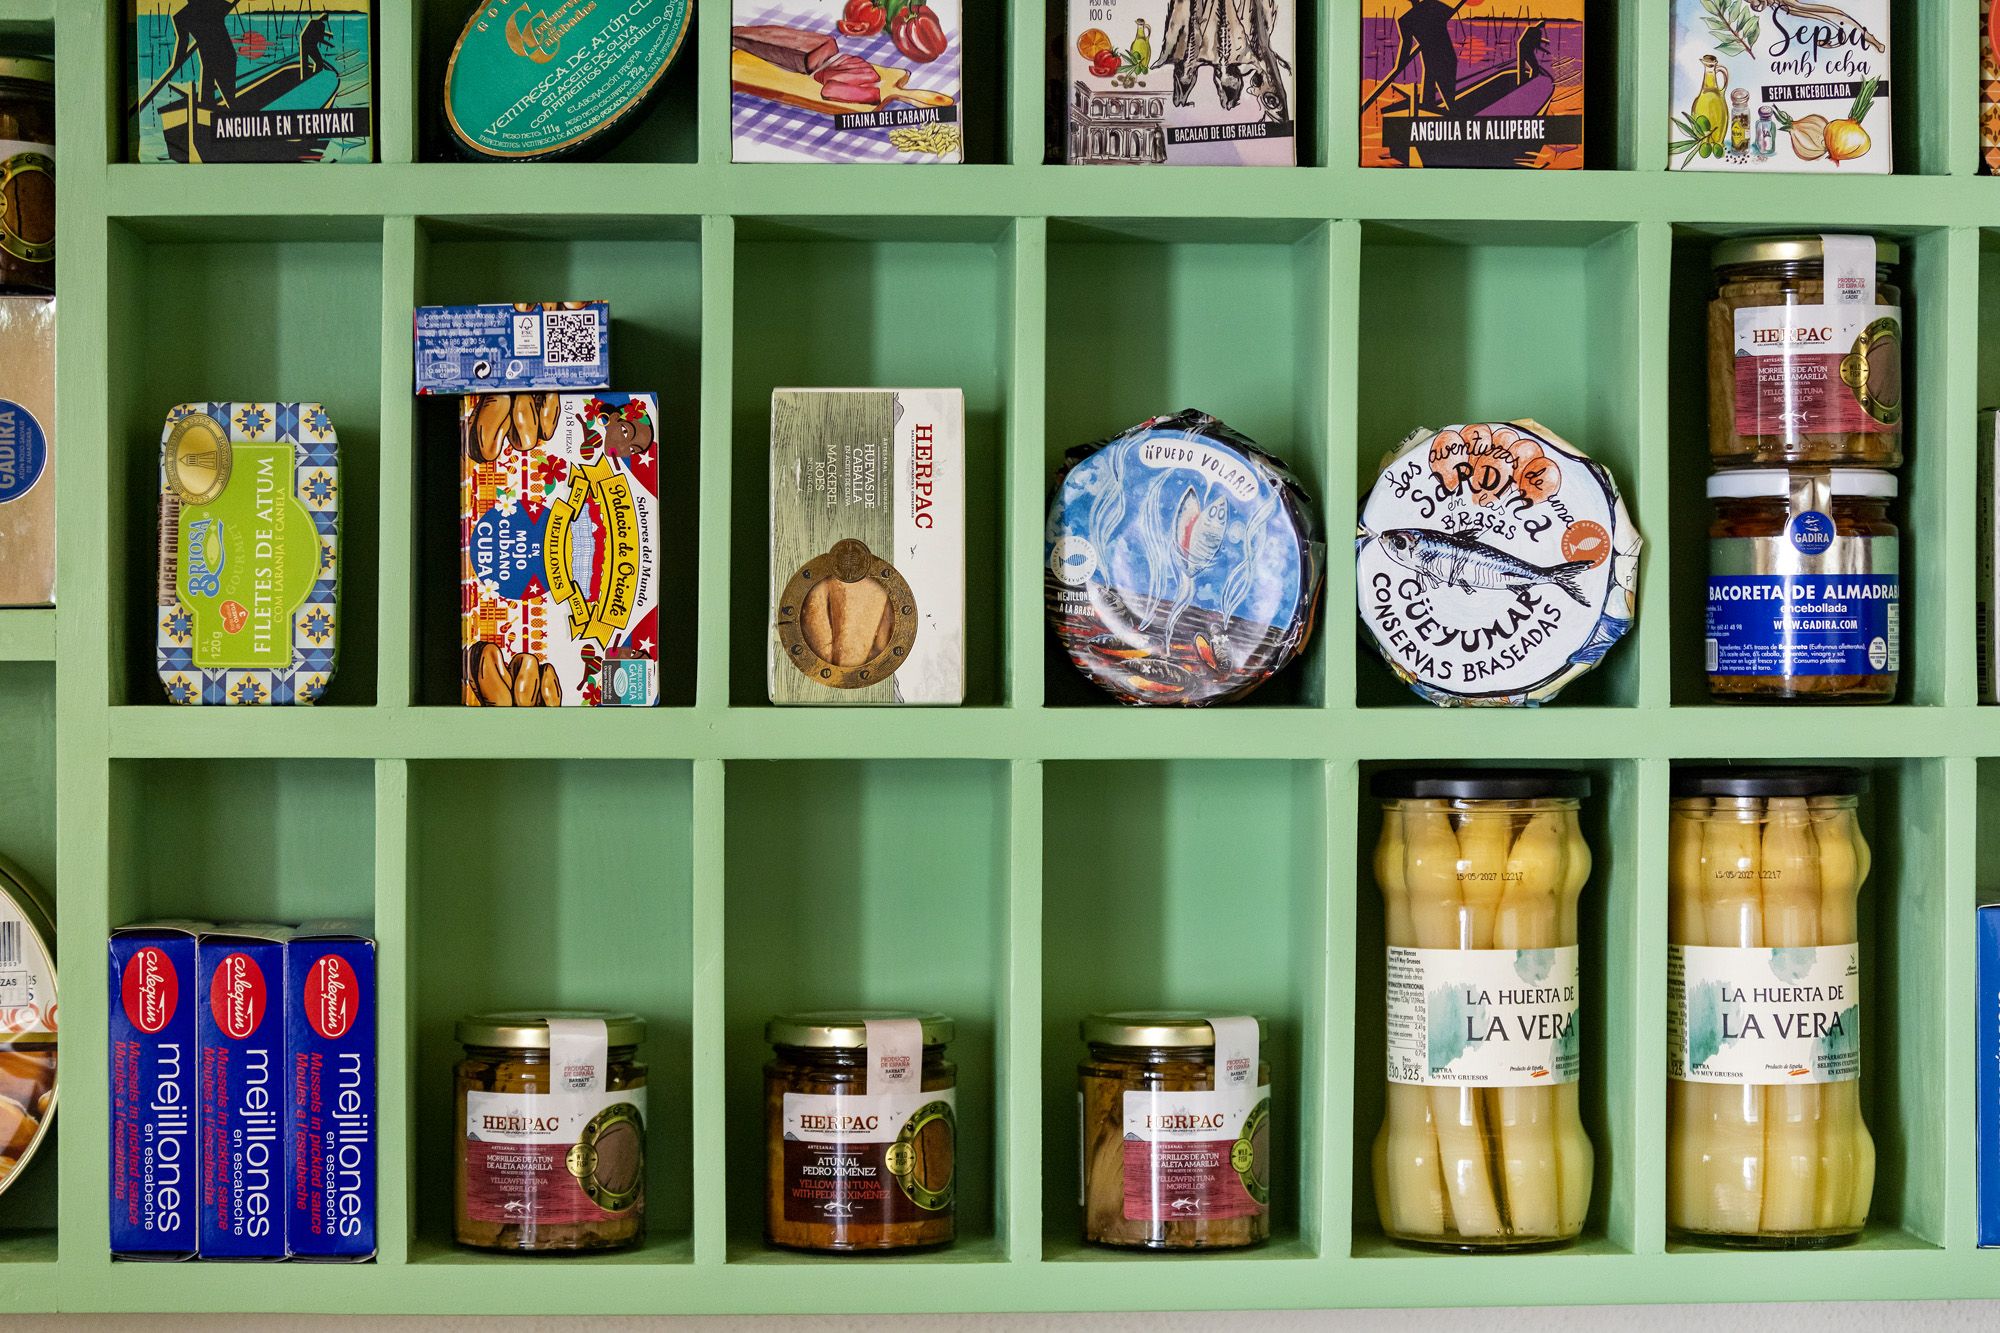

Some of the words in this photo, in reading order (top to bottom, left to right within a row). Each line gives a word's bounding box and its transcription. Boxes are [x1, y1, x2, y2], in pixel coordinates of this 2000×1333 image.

[1089, 9, 1103, 20] 100
[1106, 9, 1112, 20] G
[1768, 4, 1870, 62] Sepia
[484, 67, 570, 136] VENTRESCA
[566, 46, 590, 68] DE
[591, 13, 630, 50] ATÚN
[530, 108, 553, 128] CON
[551, 67, 602, 112] PIMIENTOS
[599, 52, 622, 70] DEL
[619, 16, 663, 54] PIQUILLO
[541, 92, 558, 107] EN
[557, 62, 593, 95] ACEITE
[591, 50, 608, 65] DE
[606, 24, 640, 52] OLIVA
[618, 50, 643, 76] PROPIA
[1771, 50, 1816, 78] amb
[1825, 50, 1871, 76] ceba
[1768, 87, 1792, 100] SEPIA
[216, 115, 271, 138] ANGUILA
[276, 114, 292, 135] EN
[297, 113, 354, 135] TERIYAKI
[842, 113, 876, 128] TITAINA
[879, 111, 894, 125] DEL
[897, 108, 940, 123] CABANYAL
[1174, 127, 1209, 142] BACALAO
[1210, 127, 1220, 140] DE
[1222, 125, 1236, 139] LOS
[1238, 123, 1267, 137] FRAILES
[1410, 121, 1461, 141] ANGUILA
[1466, 120, 1481, 140] EN
[1485, 119, 1545, 140] ALLIPEBRE
[565, 400, 575, 427] 13/18
[565, 429, 573, 455] PIEZAS
[815, 462, 825, 491] ROES
[827, 444, 837, 508] MACKEREL
[852, 448, 863, 504] CABALLA
[864, 444, 875, 490] HUEVAS
[915, 423, 933, 529] HERPAC
[1145, 444, 1193, 461] ¡¡PUEDO
[1201, 453, 1257, 498] VOLAR!!
[1428, 430, 1520, 471] aventuras
[1524, 467, 1547, 491] de
[1546, 493, 1576, 531] una
[256, 456, 274, 523] ATUM
[276, 487, 285, 533] CANELA
[573, 487, 584, 505] EST.
[865, 492, 875, 509] DE
[1447, 496, 1467, 512] en
[1478, 492, 1506, 516] las
[608, 484, 628, 541] Palacio
[636, 496, 651, 544] Sabores
[188, 517, 213, 597] BRIOSA
[255, 529, 273, 559] DE
[477, 521, 493, 578] CUBA
[531, 543, 541, 557] EN
[547, 514, 563, 591] MEJILLONES
[617, 543, 629, 559] de
[641, 545, 652, 562] del
[1795, 532, 1830, 544] GADIRA
[274, 546, 285, 604] LARANJA
[609, 561, 632, 617] Oriente
[636, 563, 651, 607] Mundo
[1709, 584, 1785, 601] BACORETA
[1791, 584, 1816, 600] DE
[254, 567, 272, 653] FILETES
[274, 604, 284, 624] COM
[572, 597, 584, 616] 1873
[1064, 603, 1073, 614] LA
[1074, 604, 1095, 617] BRASA
[1372, 572, 1453, 681] CONSERVAS
[1462, 603, 1562, 682] BRASEADAS
[628, 663, 637, 701] GALICIA
[139, 951, 164, 1024] arlequin
[227, 957, 253, 1030] arlequin
[321, 958, 346, 1030] arlequin
[1467, 990, 1492, 1005] LA
[1498, 987, 1561, 1005] HUERTA
[1563, 985, 1575, 1002] DE
[1722, 987, 1747, 1003] LA
[1753, 987, 1824, 1003] HUERTA
[1828, 984, 1844, 1000] DE
[1466, 1014, 1511, 1043] LA
[1516, 1012, 1575, 1041] VERA
[1722, 1013, 1766, 1040] LA
[1773, 1011, 1845, 1040] VERA
[114, 1041, 126, 1095] Moules
[128, 1041, 141, 1103] Mussels
[203, 1046, 216, 1101] Moules
[217, 1046, 230, 1109] Mussels
[295, 1052, 309, 1106] Moules
[310, 1051, 324, 1114] Mussels
[1402, 1068, 1420, 1081] 325
[129, 1105, 140, 1120] in
[144, 1123, 154, 1142] en
[217, 1111, 229, 1126] in
[311, 1116, 323, 1131] in
[483, 1115, 559, 1132] HERPAC
[800, 1114, 878, 1130] HERPAC
[127, 1123, 141, 1177] pickled
[151, 1043, 187, 1231] mejillones
[216, 1128, 230, 1183] pickled
[233, 1129, 243, 1148] en
[240, 1049, 276, 1237] mejillones
[326, 1131, 336, 1150] en
[332, 1053, 369, 1238] mejillones
[309, 1133, 324, 1189] pickled
[802, 1166, 832, 1176] PEDRO
[832, 1166, 877, 1177] XIMÉNEZ
[817, 1155, 845, 1167] ATÚN
[846, 1158, 860, 1167] AL
[1184, 1160, 1219, 1168] AMARILLA
[129, 1180, 139, 1226] sauce
[144, 1146, 157, 1231] escabeche
[233, 1152, 246, 1236] escabeche
[326, 1154, 338, 1235] escabeche
[792, 1188, 815, 1198] WITH
[815, 1189, 845, 1199] PEDRO
[847, 1189, 891, 1200] XIMÉNEZ
[852, 1180, 881, 1189] TUNA
[1166, 1182, 1206, 1190] MORRILLOS
[217, 1186, 229, 1231] sauce
[311, 1191, 322, 1236] sauce
